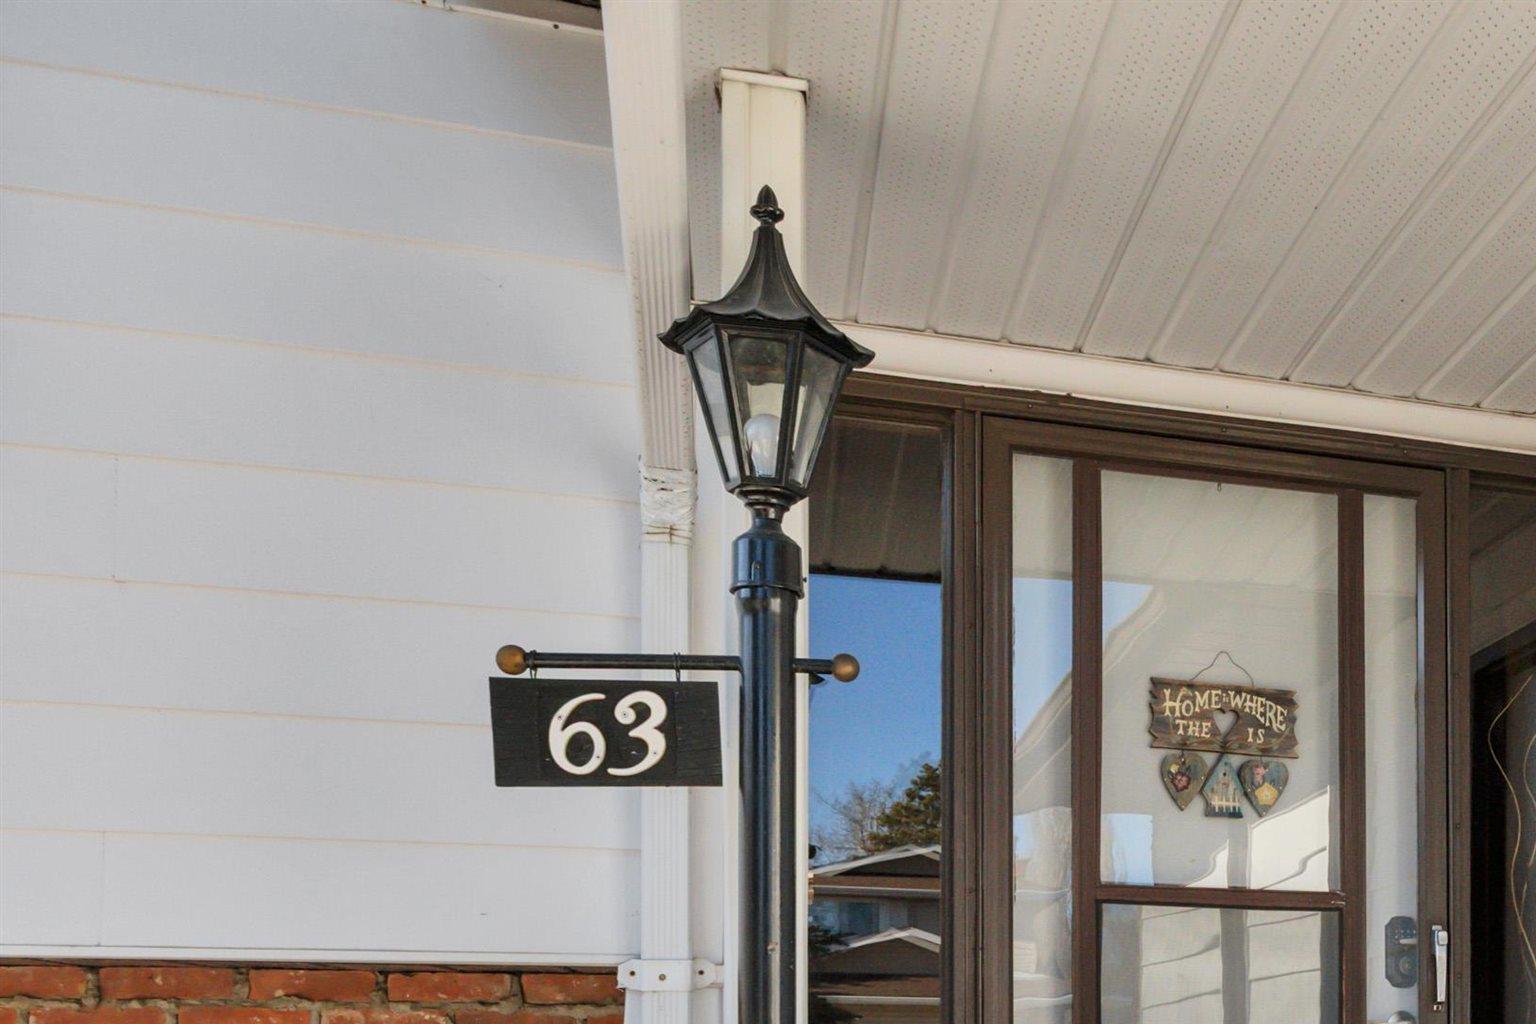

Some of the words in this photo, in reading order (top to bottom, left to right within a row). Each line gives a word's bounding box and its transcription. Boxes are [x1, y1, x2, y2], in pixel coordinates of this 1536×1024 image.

[549, 690, 667, 775] 63
[1175, 719, 1212, 738] THE
[1247, 727, 1265, 744] IS
[1228, 690, 1288, 733] WHERE
